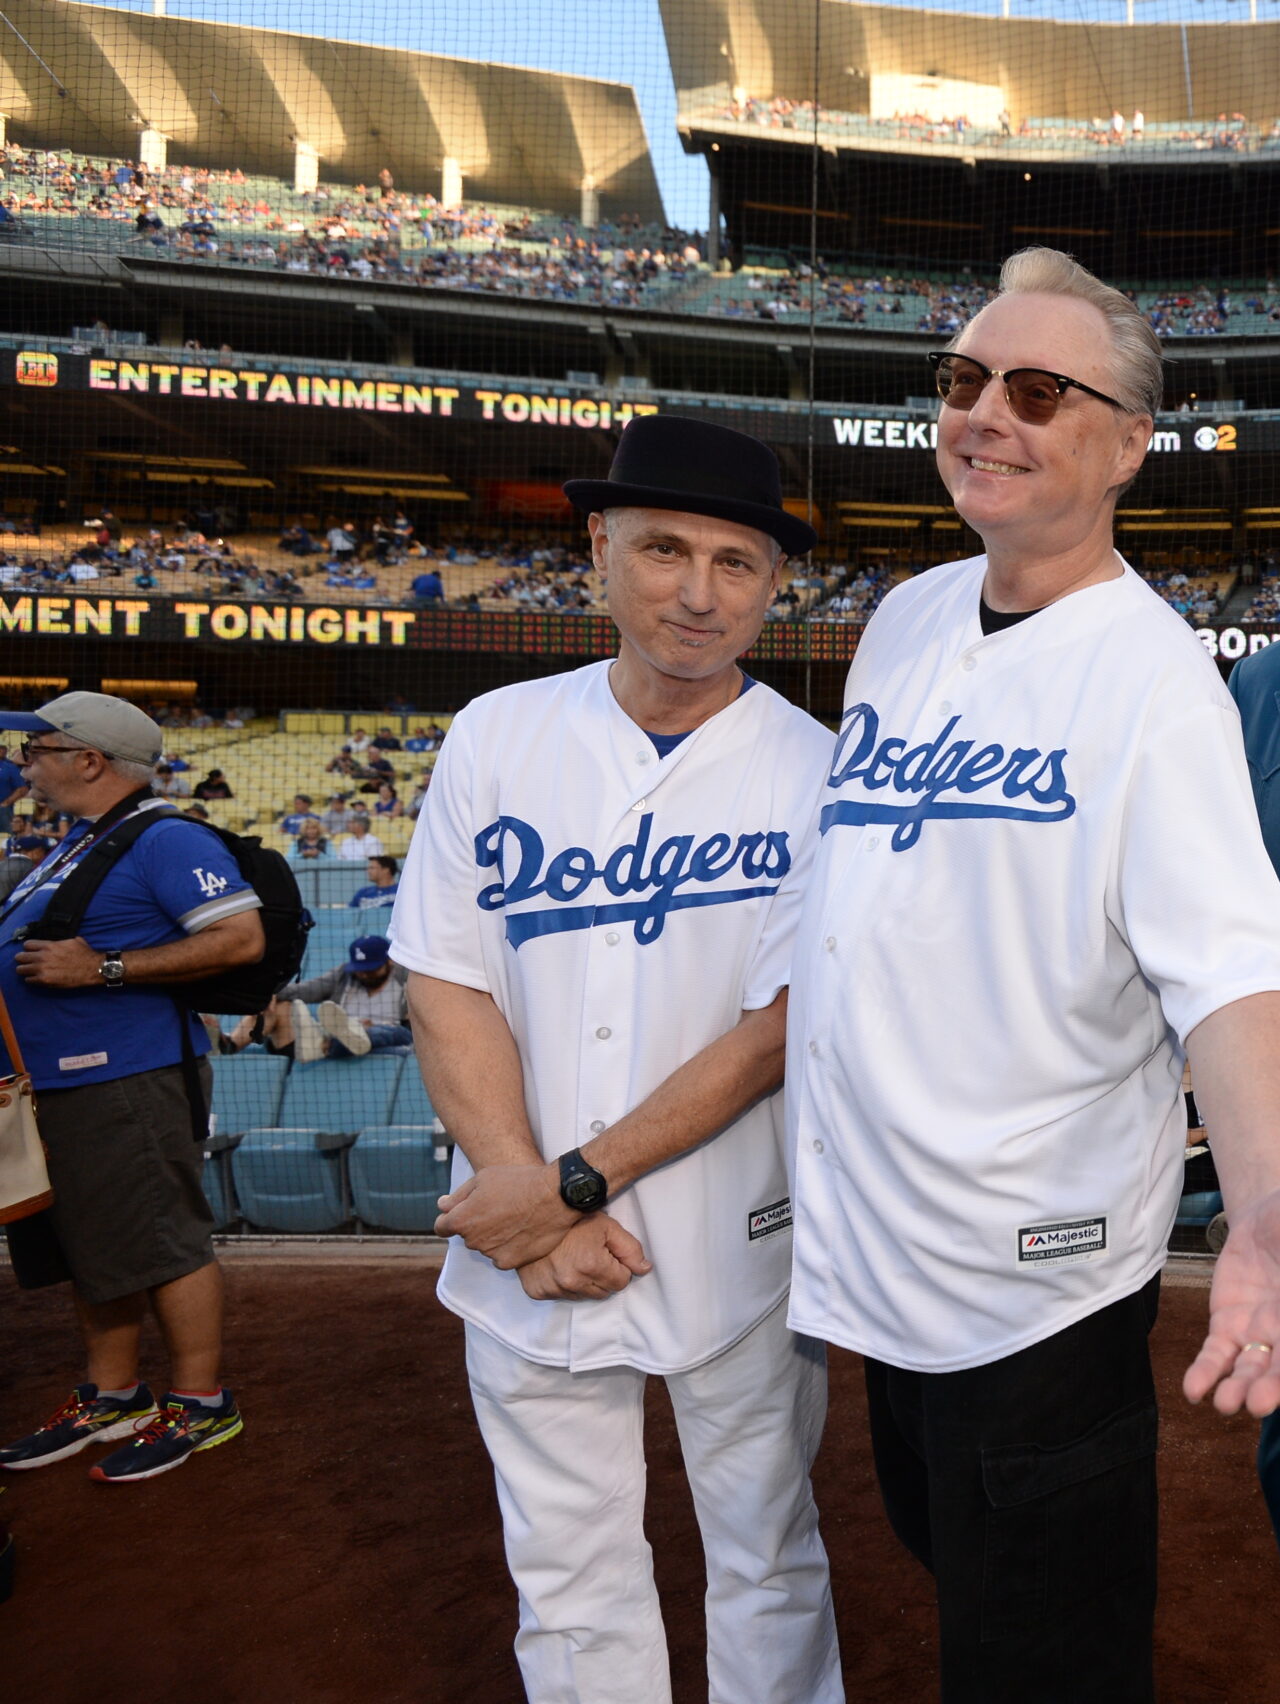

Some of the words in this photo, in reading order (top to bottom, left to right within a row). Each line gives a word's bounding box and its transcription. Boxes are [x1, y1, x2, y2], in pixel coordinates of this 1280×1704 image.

[89, 358, 460, 416] ENTERTAINMENT
[174, 602, 416, 646] TONIGHT
[827, 703, 1073, 852] Dodgers
[192, 868, 228, 897] LA
[474, 812, 792, 946] Dodgers
[1047, 1227, 1099, 1245] Majestic
